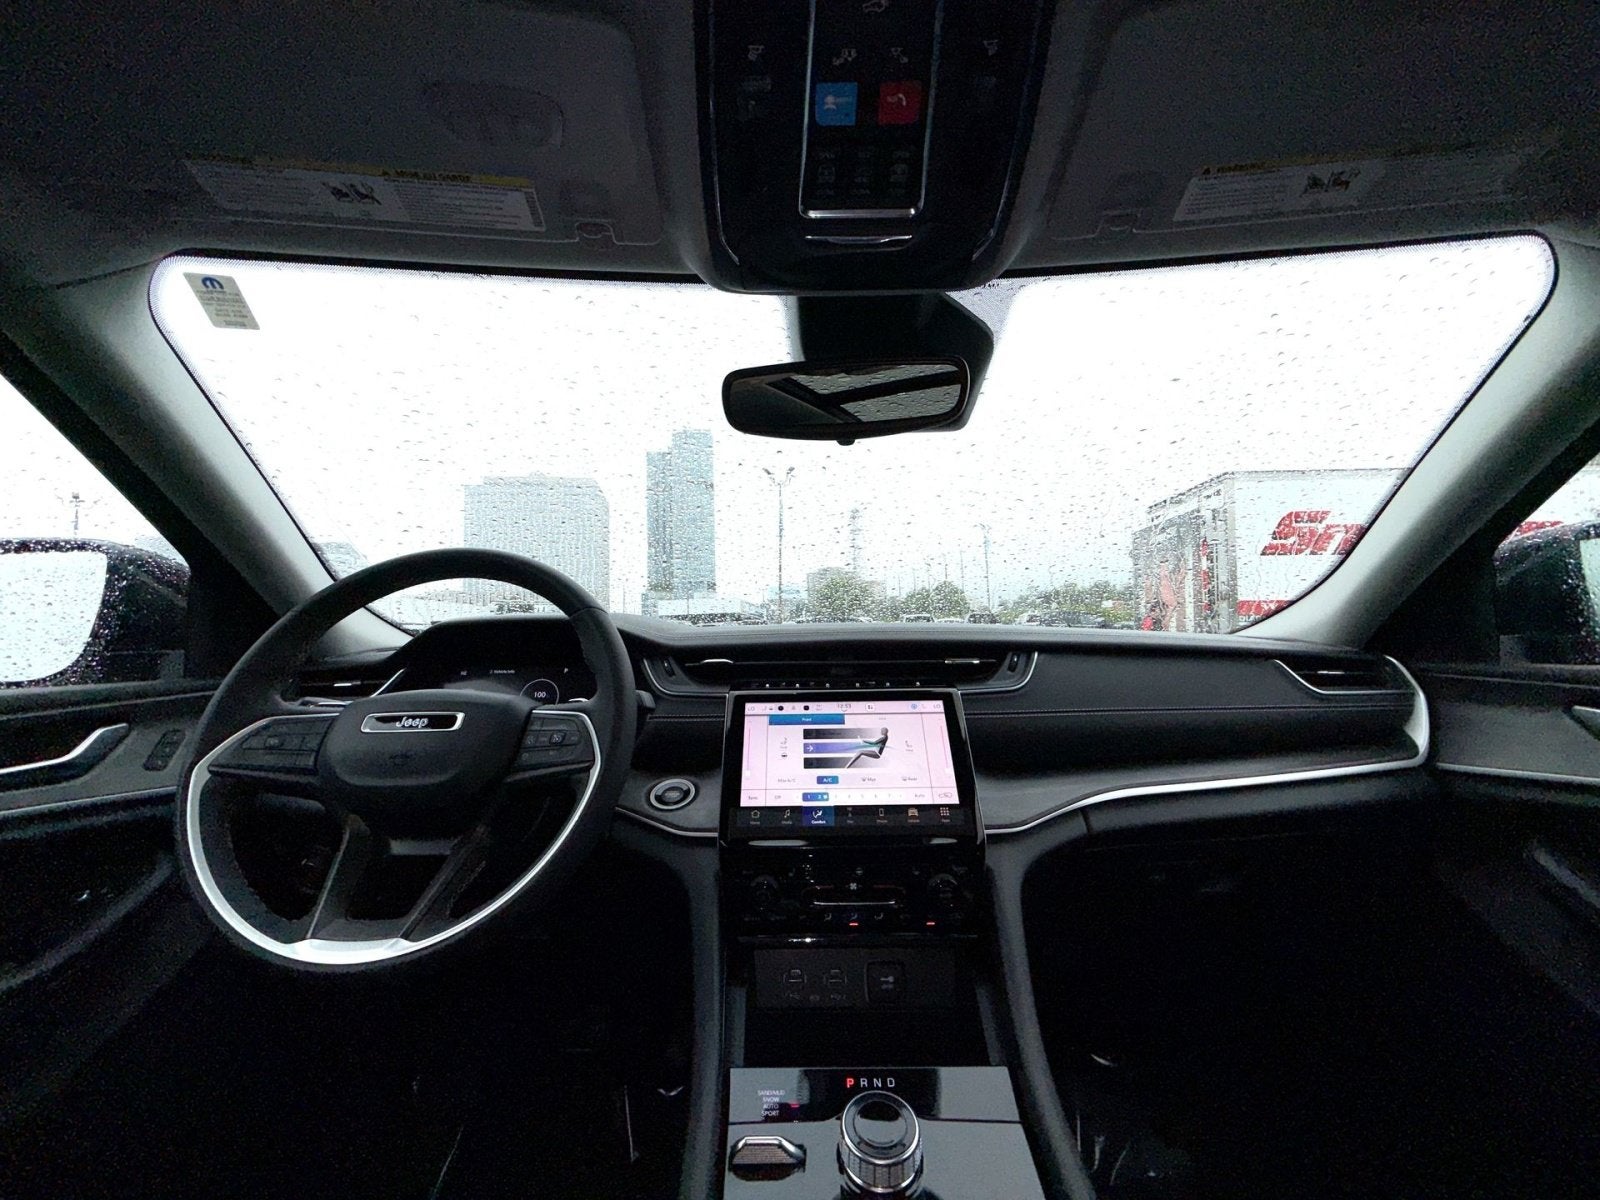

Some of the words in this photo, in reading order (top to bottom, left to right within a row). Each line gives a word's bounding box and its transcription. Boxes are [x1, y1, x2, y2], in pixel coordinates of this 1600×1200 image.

[395, 716, 429, 729] Jeep
[846, 1077, 855, 1088] P
[860, 1077, 868, 1088] R
[873, 1077, 882, 1088] N
[887, 1077, 896, 1088] D
